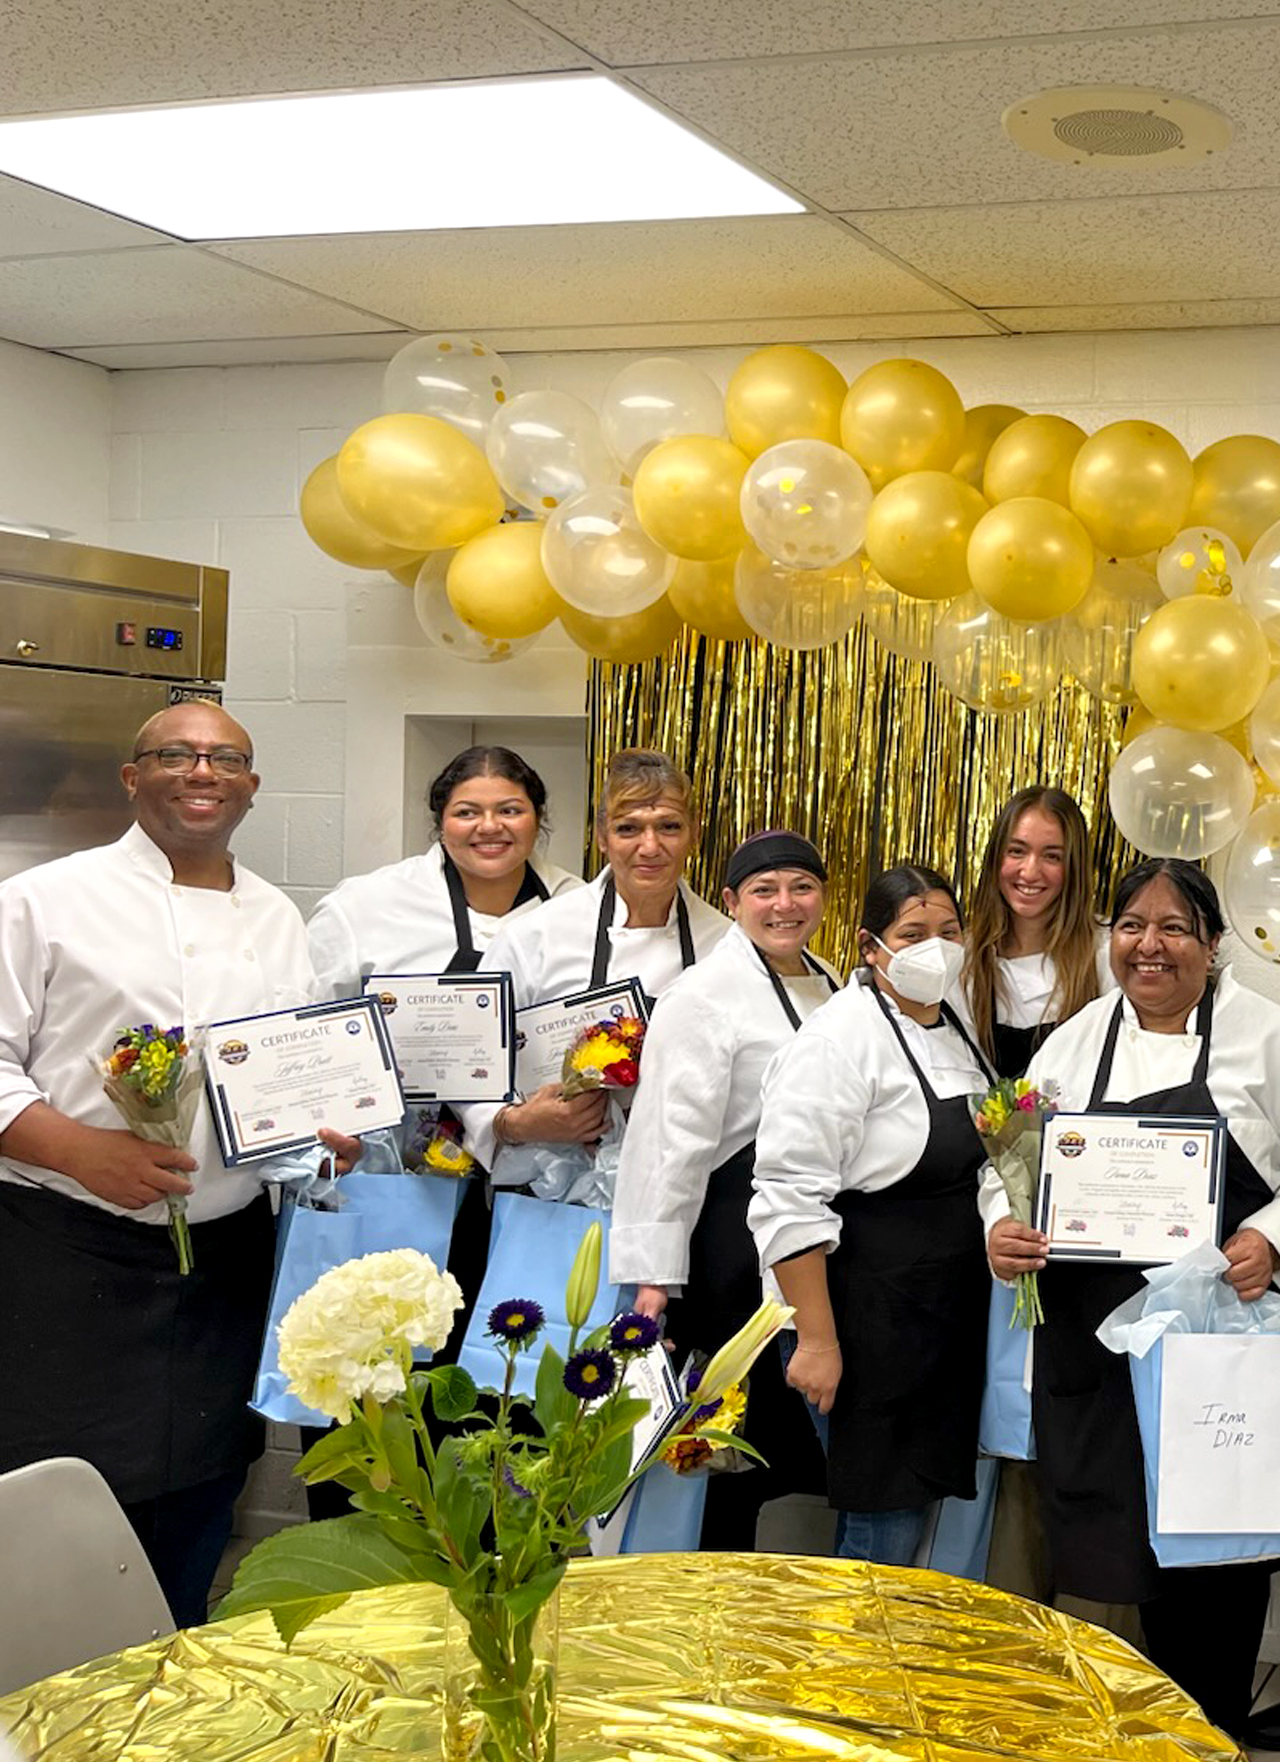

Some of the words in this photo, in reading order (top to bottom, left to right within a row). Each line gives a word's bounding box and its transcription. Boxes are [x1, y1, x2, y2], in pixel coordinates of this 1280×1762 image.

[407, 994, 464, 1005] CERTIFICATE
[535, 1010, 597, 1035] CERTIFICATE
[260, 1024, 333, 1048] CERTIFICATE
[1098, 1137, 1168, 1150] CERTIFICATE
[1213, 1429, 1255, 1448] DIAZ
